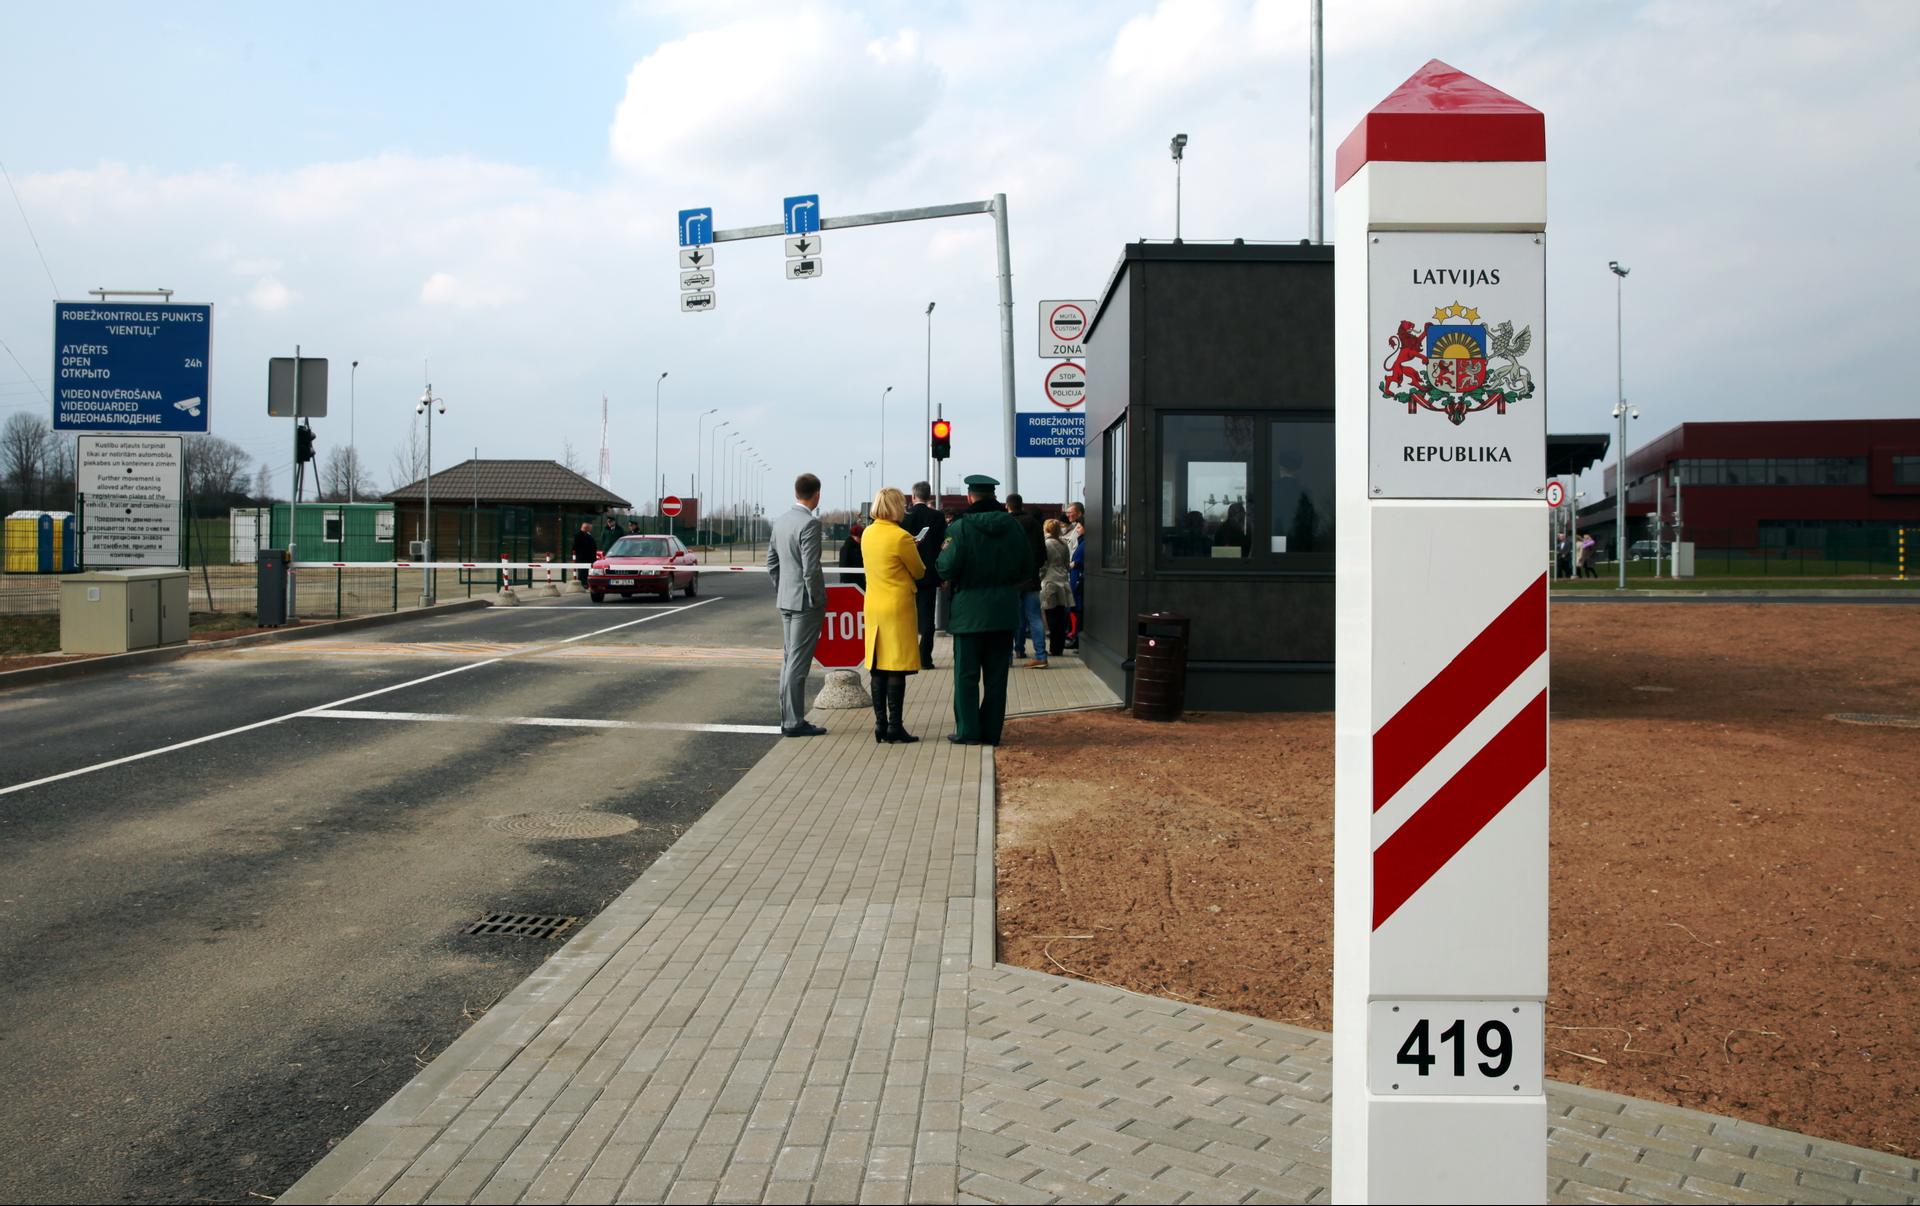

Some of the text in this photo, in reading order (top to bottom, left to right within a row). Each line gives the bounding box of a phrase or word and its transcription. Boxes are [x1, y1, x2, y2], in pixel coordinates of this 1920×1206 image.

[1413, 269, 1500, 288] LATVIJAS
[62, 309, 204, 322] ROBEŽKONTROLES PUNKTS
[62, 343, 109, 355] ATVĒRTS
[1053, 345, 1082, 354] ZONA
[62, 356, 91, 366] OPEN
[184, 358, 203, 368] 24h
[61, 368, 111, 379] ОТКРЫТО
[60, 401, 139, 412] VIDEOGUARDED
[60, 413, 162, 425] ВИДЕОНАБЛЮДЕНИЕ
[1051, 427, 1084, 436] PUNKTS
[1029, 437, 1086, 446] BORDER CON
[1055, 447, 1080, 456] POINT
[1403, 446, 1512, 462] REPUBLIKA
[136, 484, 161, 492] cleaning
[1552, 488, 1558, 501] 5
[819, 612, 865, 640] TOP
[1396, 1018, 1513, 1078] 419
